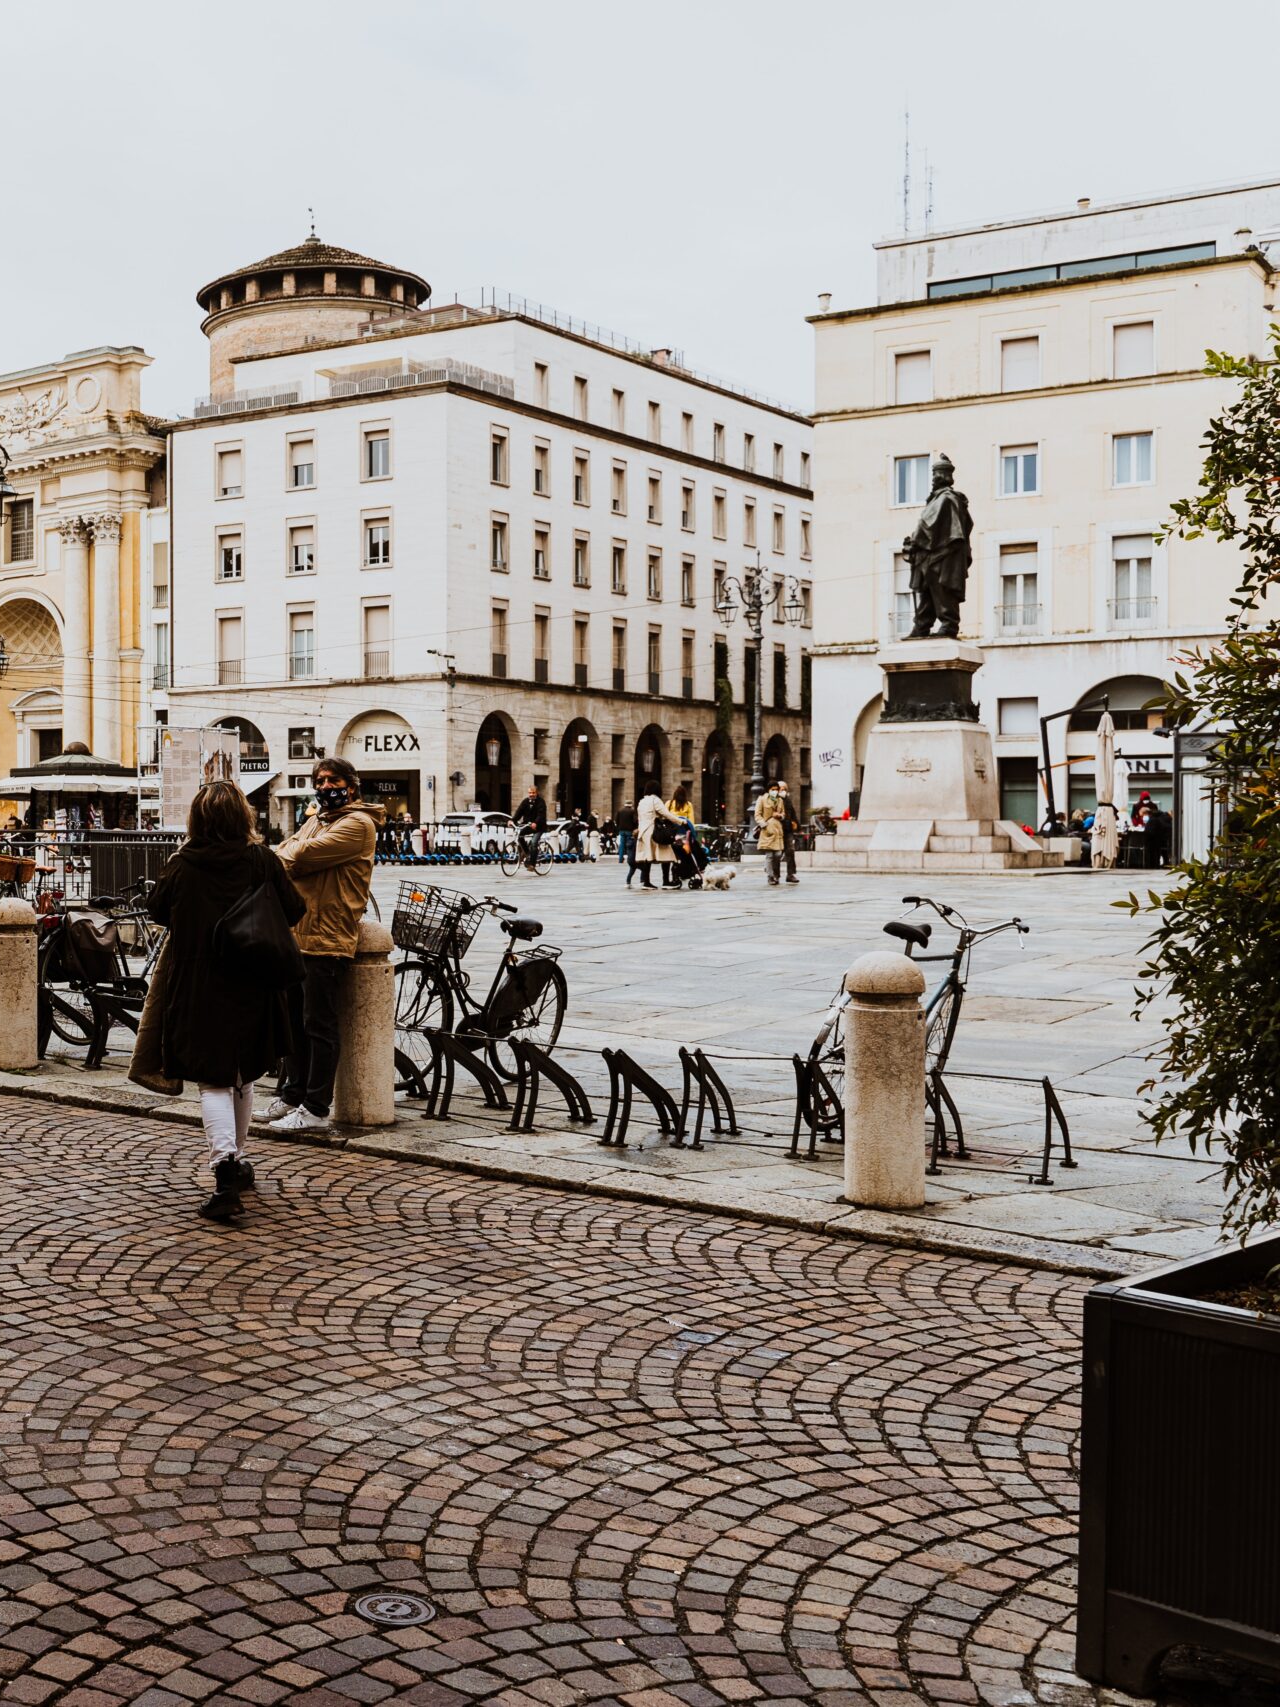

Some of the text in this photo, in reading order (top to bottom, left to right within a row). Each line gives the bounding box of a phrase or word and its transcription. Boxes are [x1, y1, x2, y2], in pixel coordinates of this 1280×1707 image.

[347, 734, 421, 752] The FLEXX
[240, 762, 269, 770] PIETRO
[378, 782, 398, 792] FLEXX
